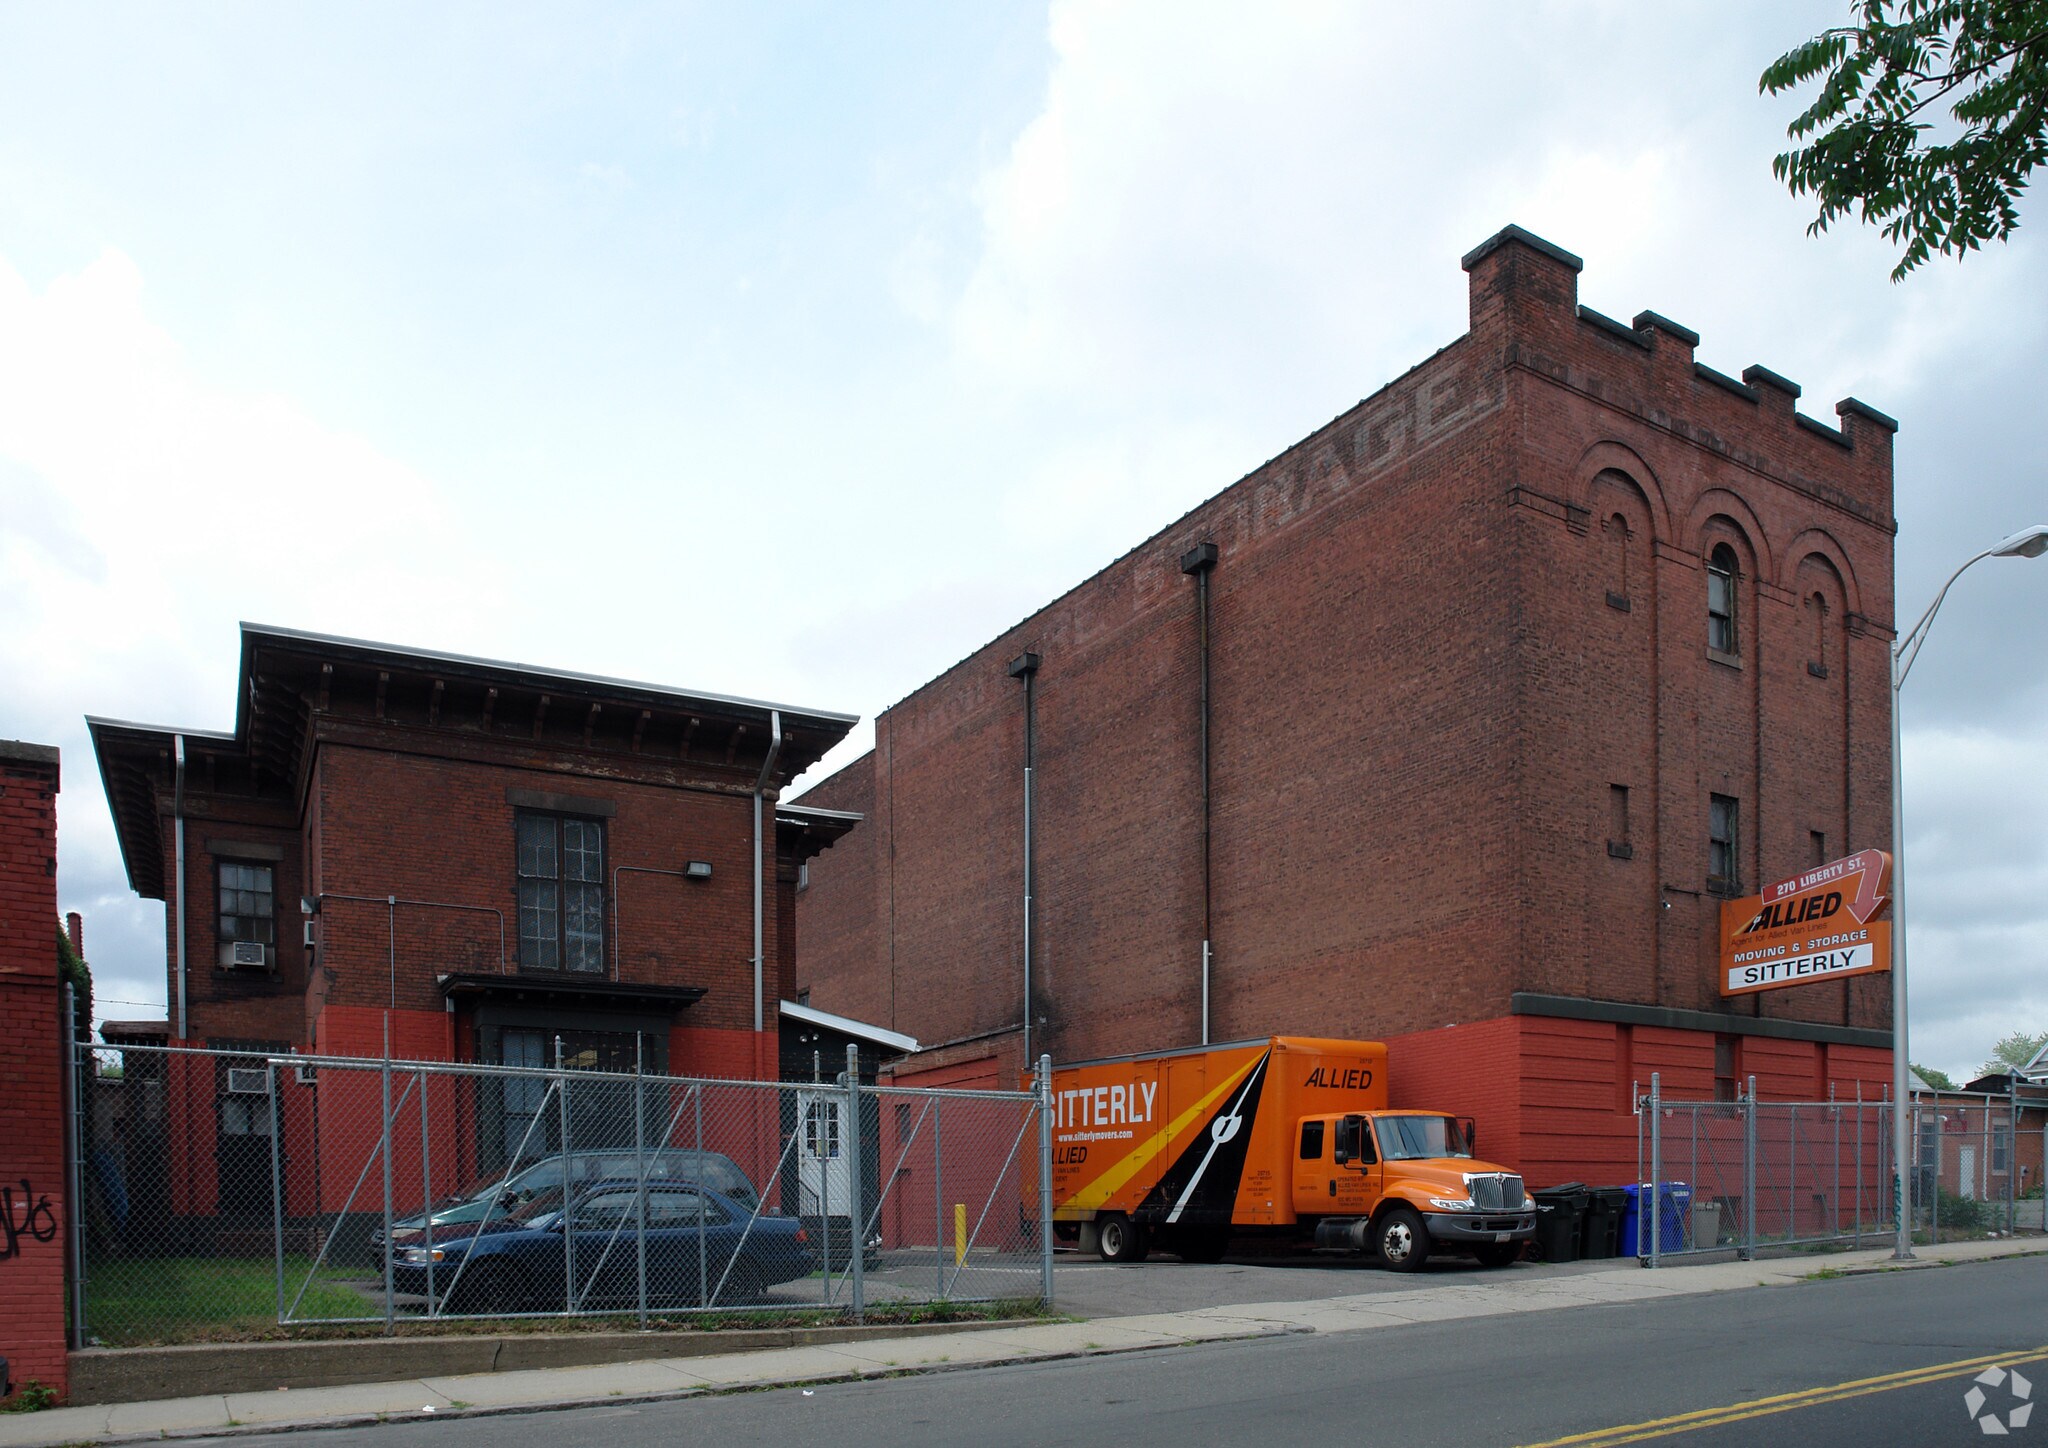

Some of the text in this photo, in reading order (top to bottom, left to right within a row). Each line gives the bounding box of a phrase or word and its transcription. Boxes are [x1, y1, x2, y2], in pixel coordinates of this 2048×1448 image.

[1777, 857, 1866, 896] 270 LIBERTY ST.
[1744, 891, 1842, 934] ALLIED
[1731, 922, 1828, 947] Agent for Allied Van Lines
[1734, 929, 1867, 963] MOVING & STORAGE
[1744, 950, 1855, 983] SITTERLY
[1304, 1067, 1373, 1089] ALLIED
[1058, 1130, 1133, 1142] www.sitterlymovers.com
